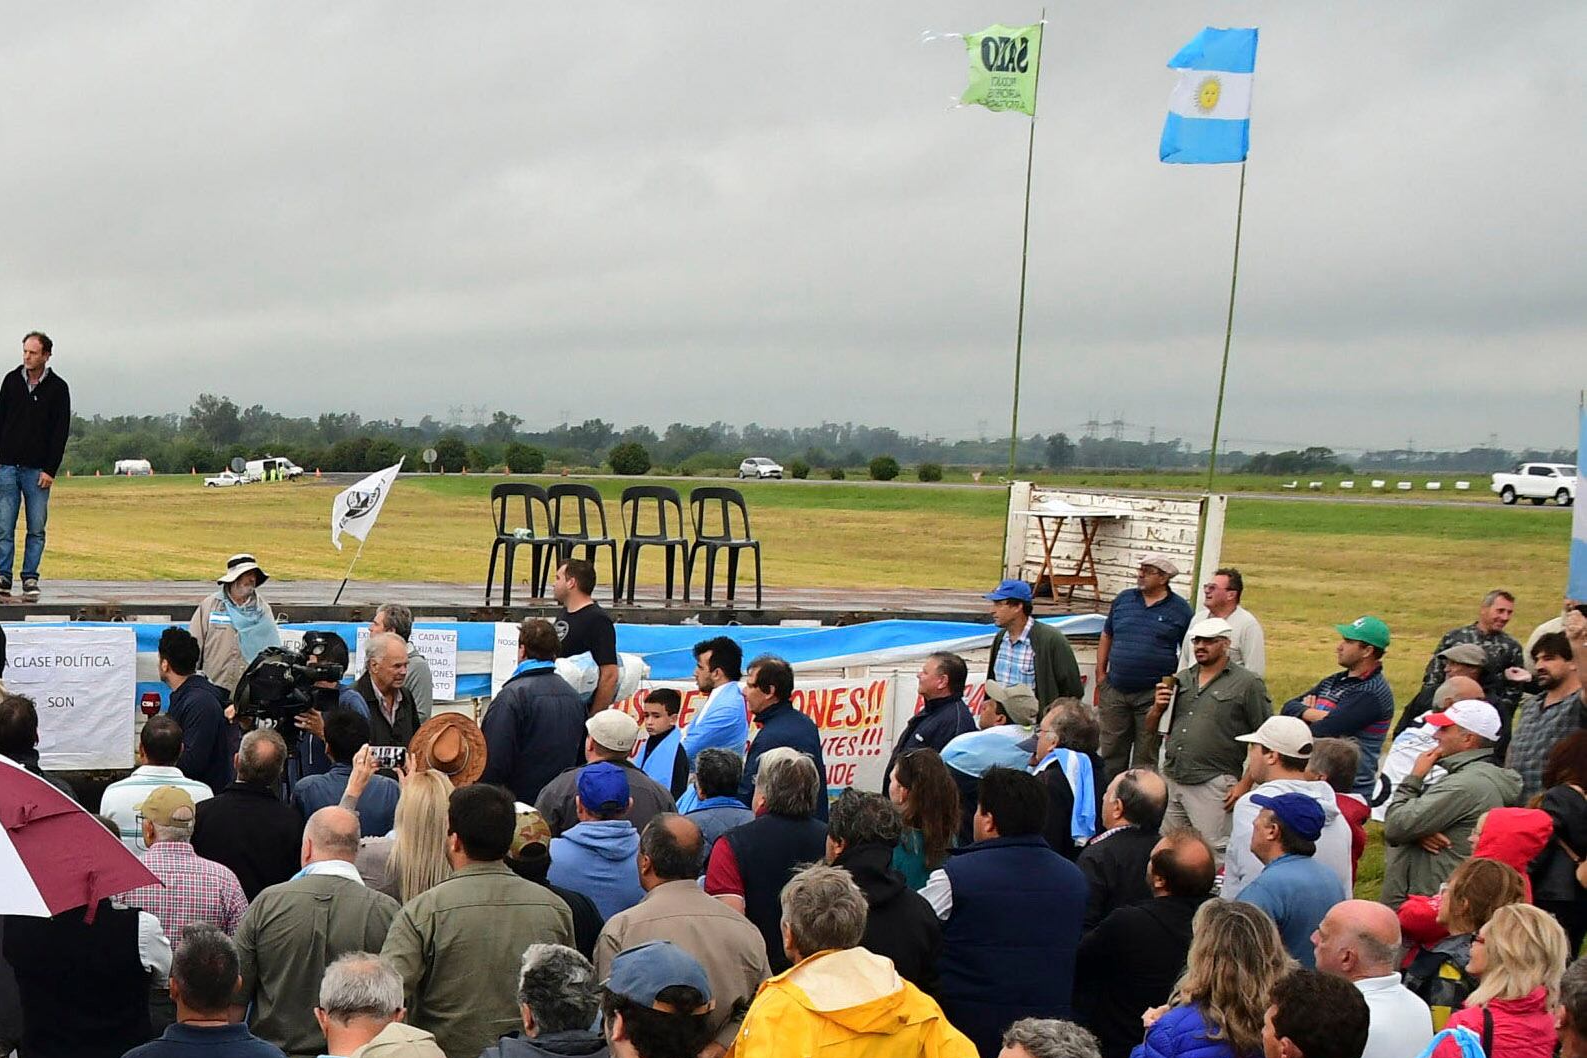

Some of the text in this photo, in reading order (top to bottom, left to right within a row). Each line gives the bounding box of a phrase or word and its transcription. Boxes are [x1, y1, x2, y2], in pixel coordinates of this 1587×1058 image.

[13, 656, 51, 668] CLASE
[55, 653, 115, 667] POLÍTICA.
[47, 696, 75, 708] SON
